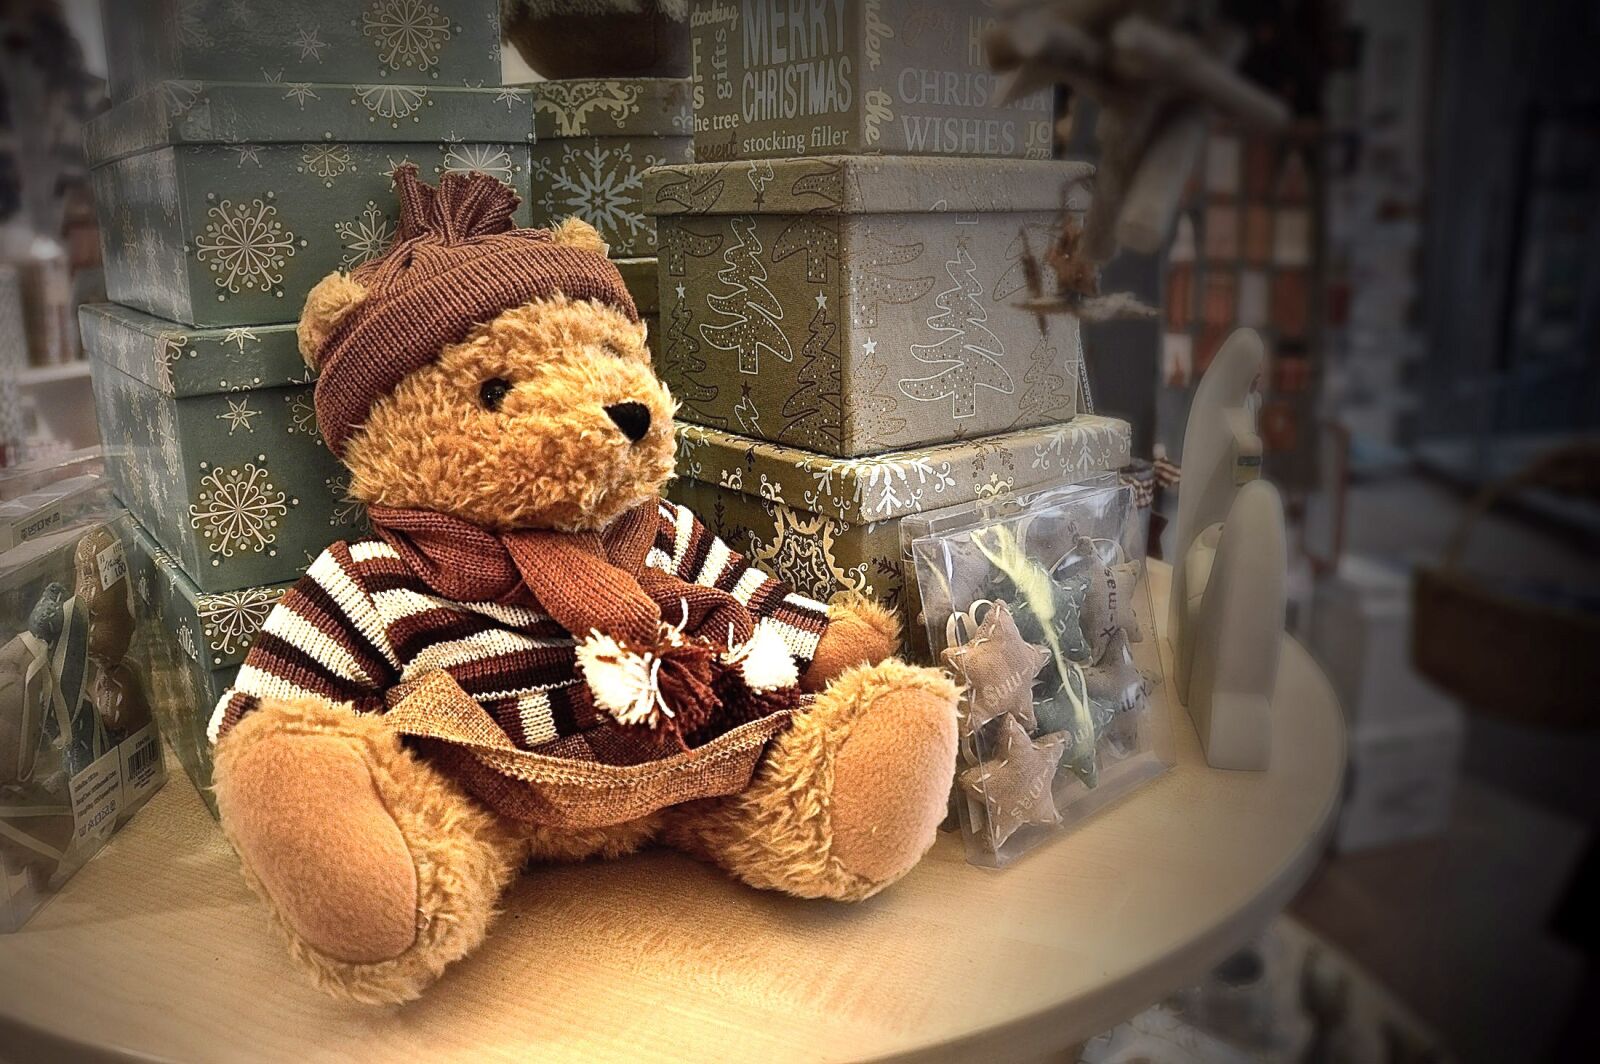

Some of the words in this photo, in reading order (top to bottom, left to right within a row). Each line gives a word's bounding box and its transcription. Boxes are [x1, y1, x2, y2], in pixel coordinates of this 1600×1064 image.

[711, 28, 733, 99] gifts
[743, 0, 846, 69] MERRY
[742, 56, 852, 124] CHRISTMAS
[865, 86, 895, 146] the
[713, 113, 740, 130] tree
[743, 130, 806, 154] stocking
[810, 125, 850, 147] filler
[900, 114, 1016, 155] WISHES
